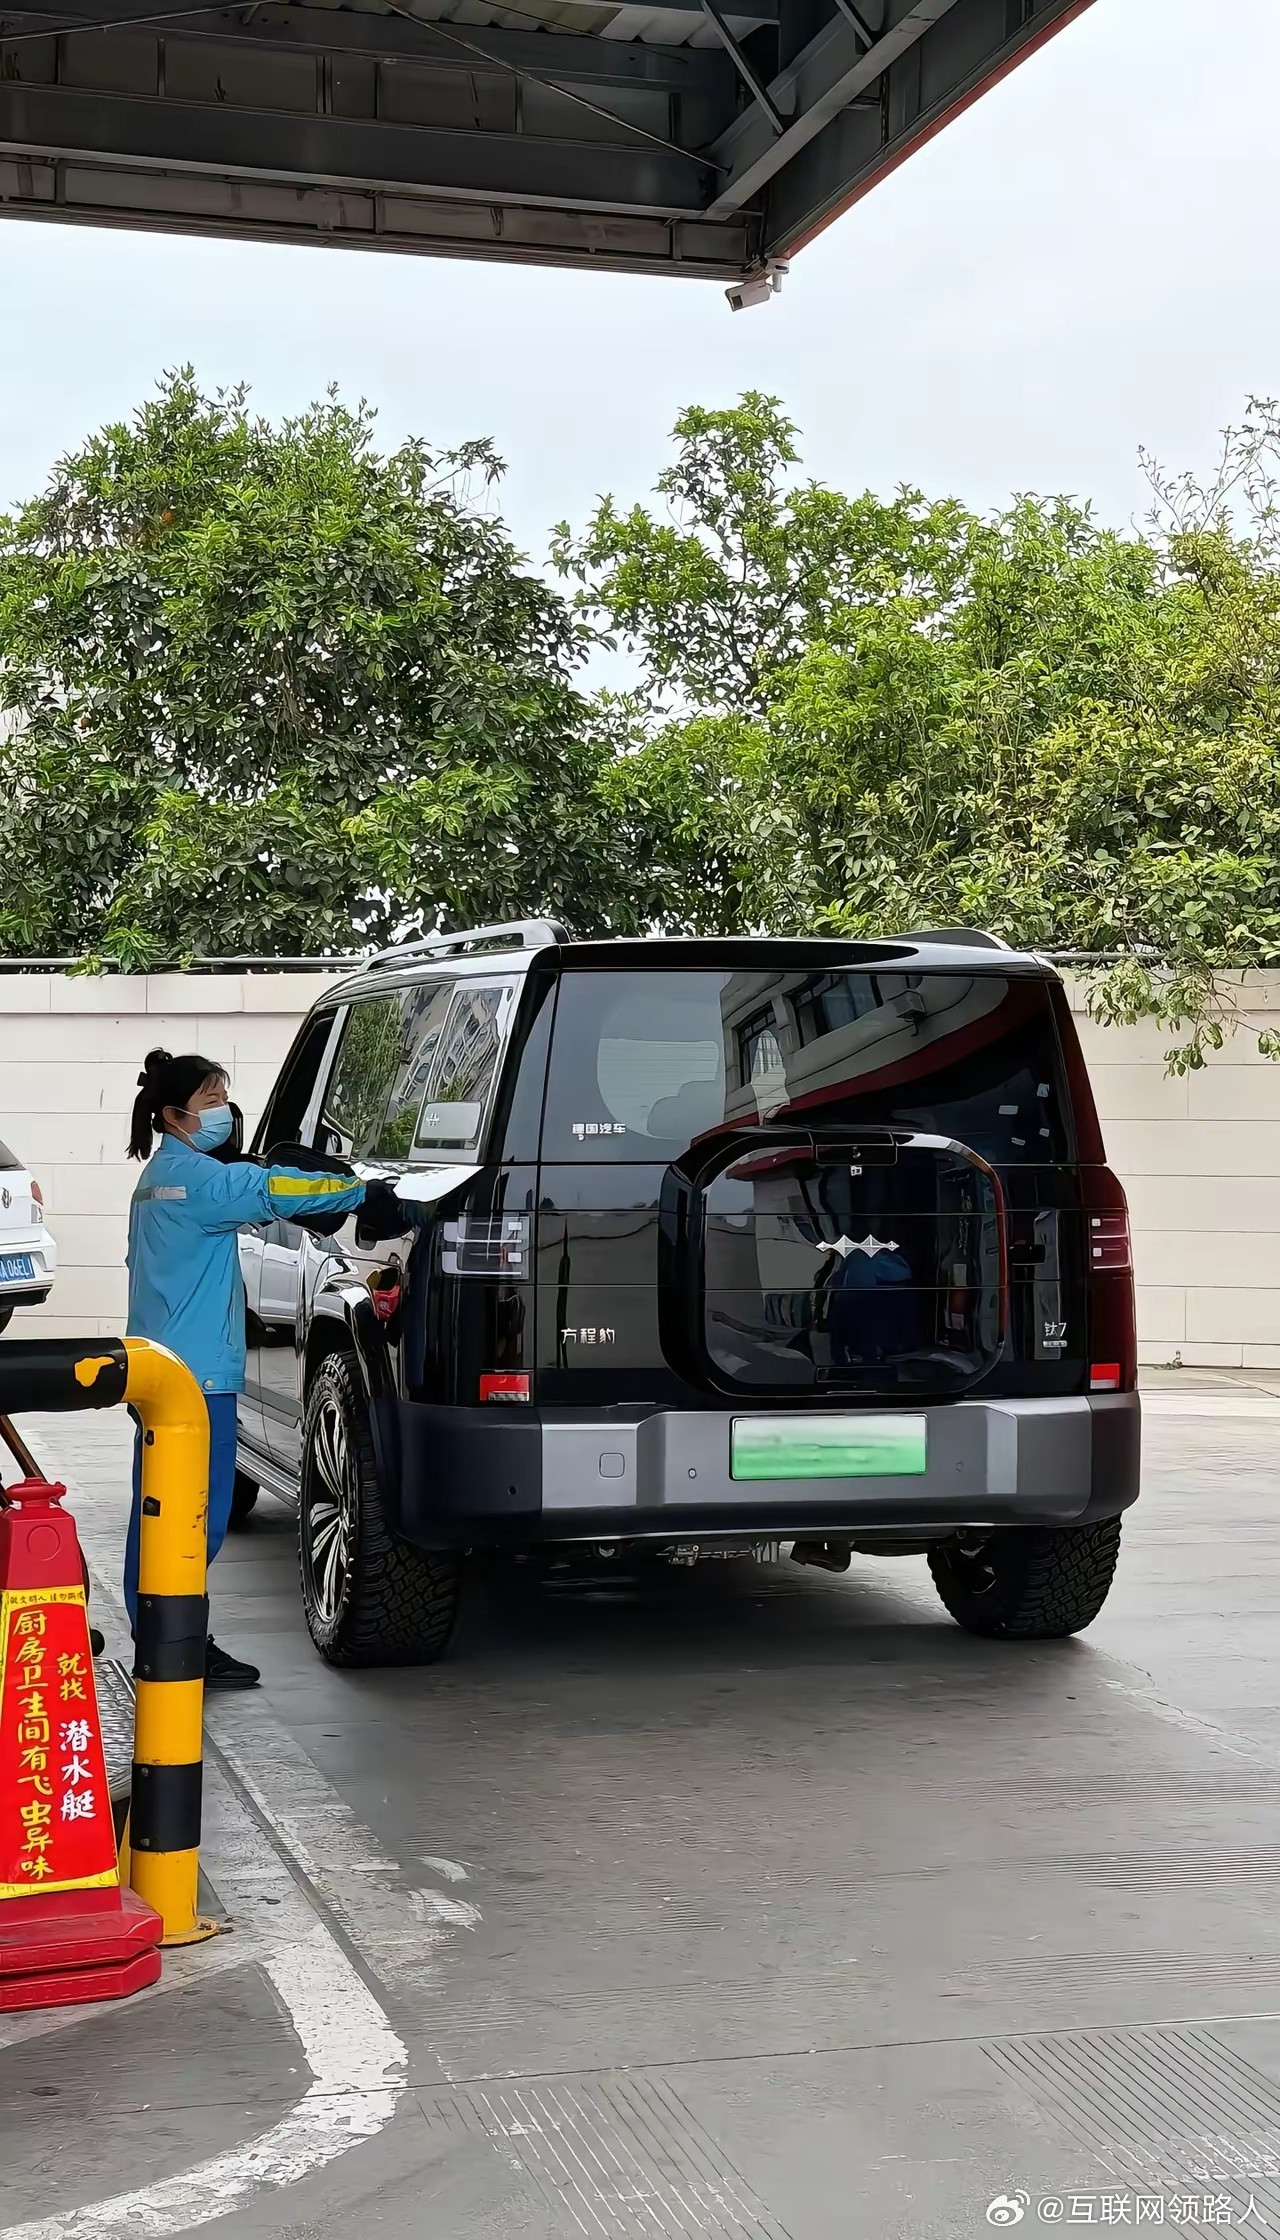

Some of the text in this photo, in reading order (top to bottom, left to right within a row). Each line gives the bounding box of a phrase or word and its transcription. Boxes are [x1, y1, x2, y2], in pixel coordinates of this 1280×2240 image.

[561, 1327, 615, 1344] 方程豹
[13, 1610, 54, 1880] 厨房卫生间有飞虫异味
[56, 1652, 97, 1822] 就找 潜水艇
